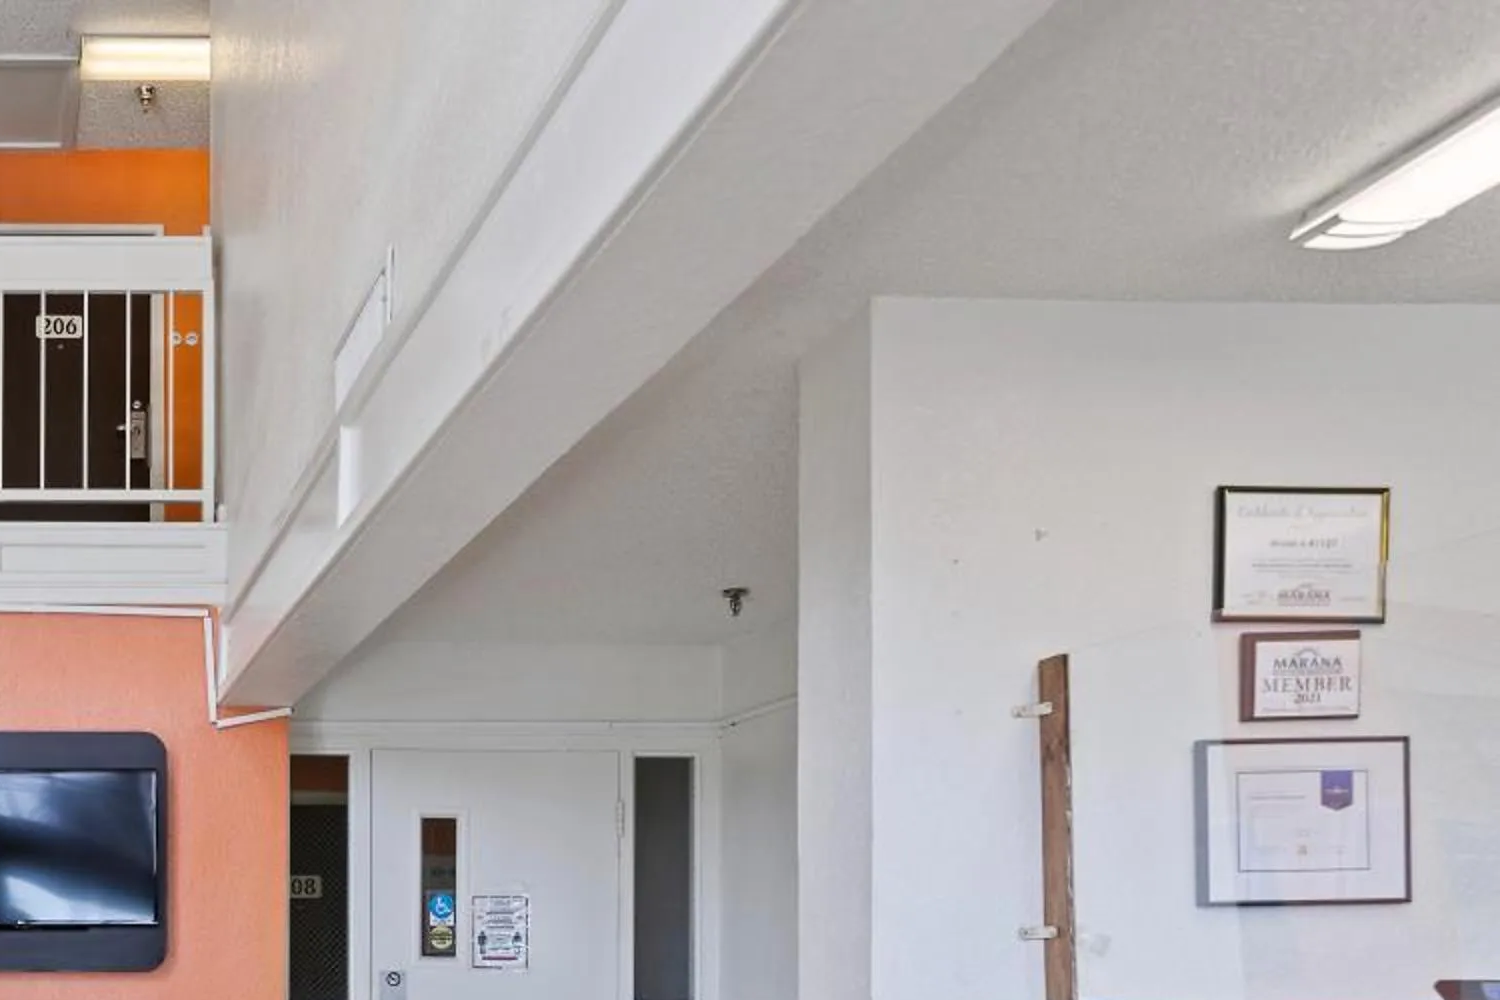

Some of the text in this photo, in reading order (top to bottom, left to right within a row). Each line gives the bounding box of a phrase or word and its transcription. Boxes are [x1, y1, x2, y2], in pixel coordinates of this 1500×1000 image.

[44, 317, 77, 335] 206
[1272, 656, 1343, 670] MARANA
[1261, 676, 1354, 693] MEMBER
